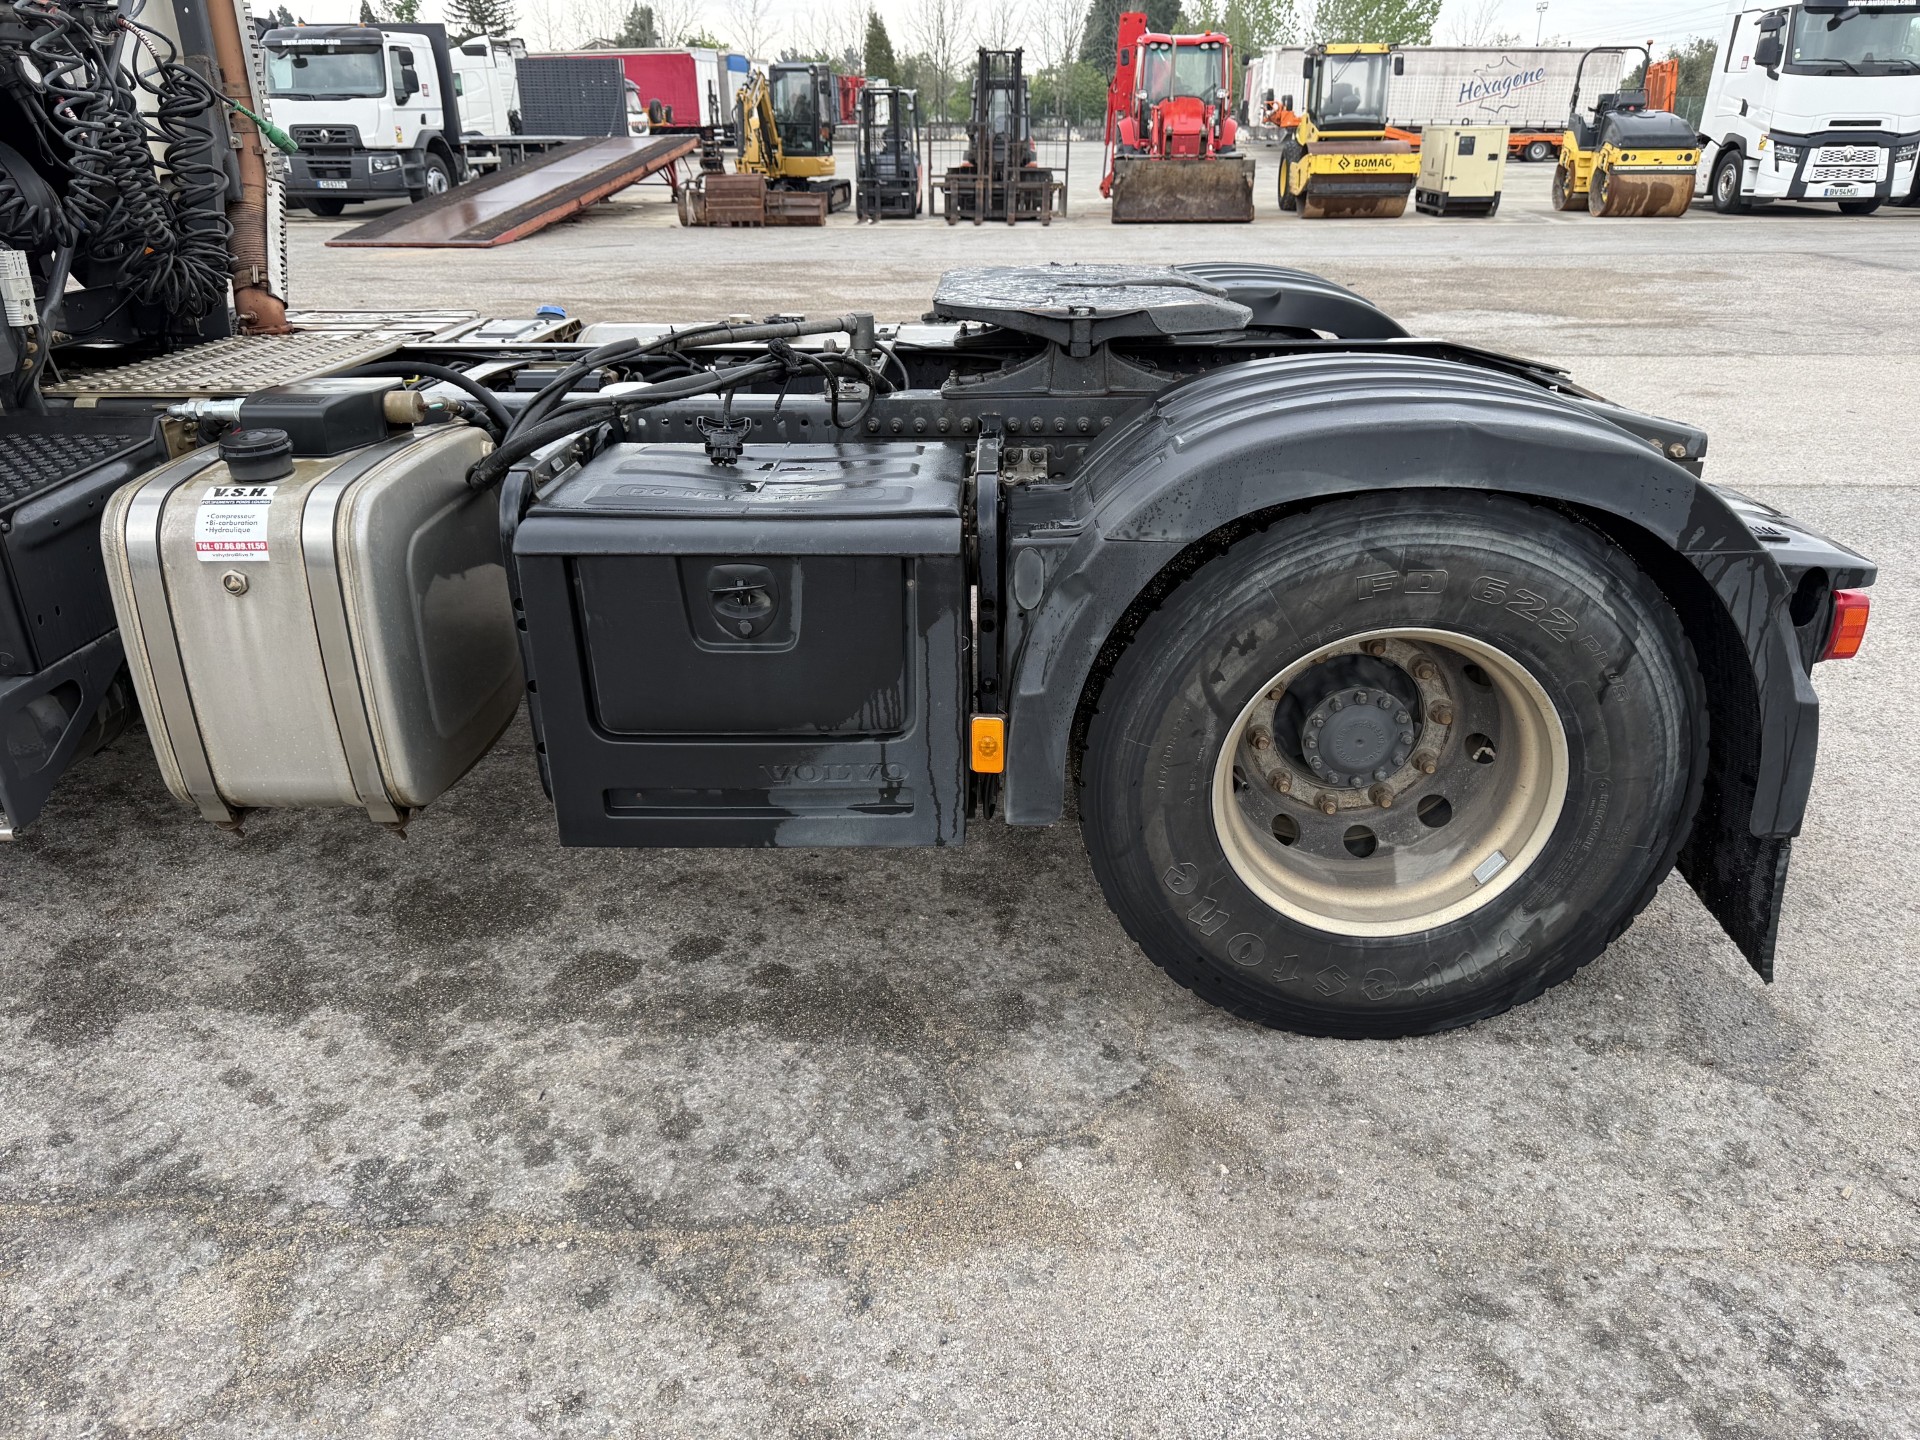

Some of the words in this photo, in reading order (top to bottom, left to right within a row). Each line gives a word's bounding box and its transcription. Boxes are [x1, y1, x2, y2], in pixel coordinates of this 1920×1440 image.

[1458, 67, 1545, 103] Hexagone
[1354, 158, 1392, 168] BOMAG
[213, 487, 268, 498] V.S.H.
[1356, 569, 1449, 601] FD
[1469, 575, 1580, 643] 622
[758, 761, 911, 784] VOLVO
[1162, 861, 1533, 1002] Firestone
